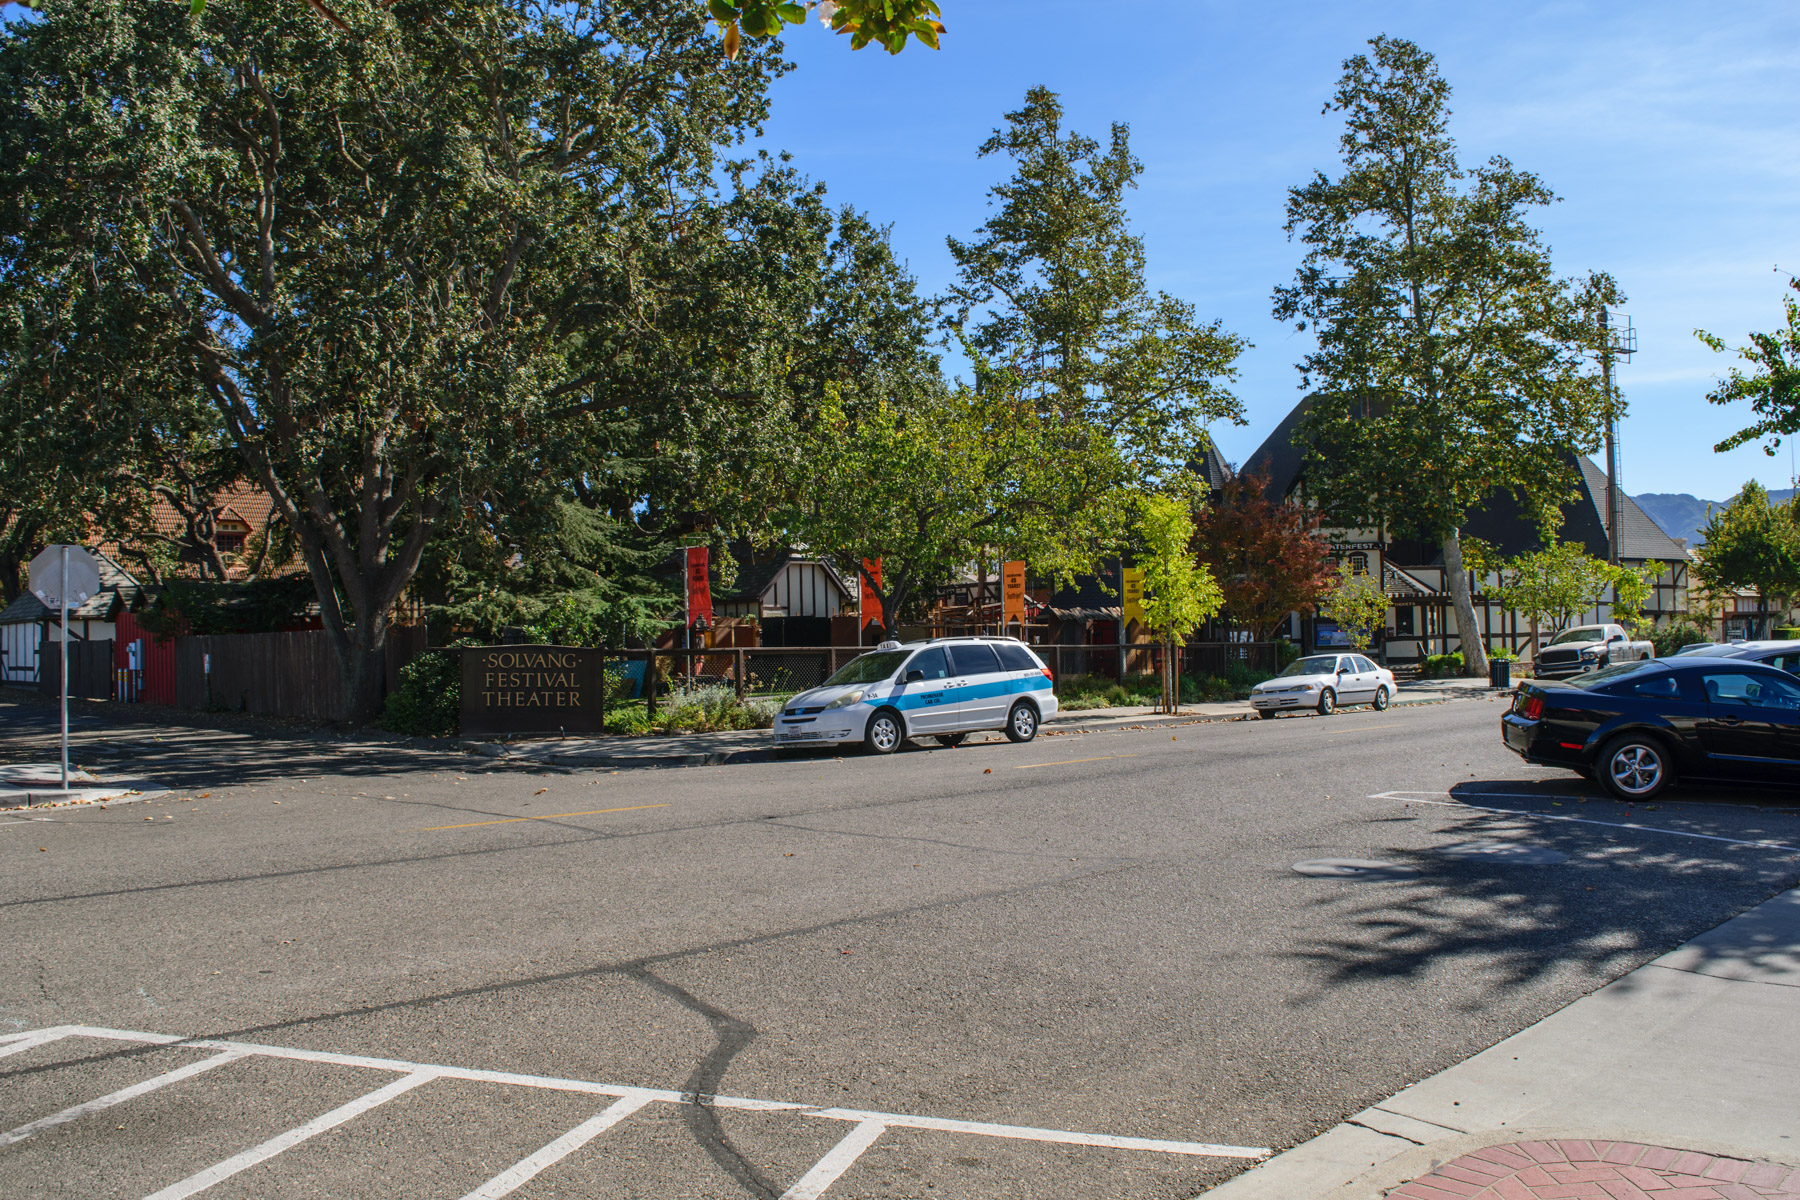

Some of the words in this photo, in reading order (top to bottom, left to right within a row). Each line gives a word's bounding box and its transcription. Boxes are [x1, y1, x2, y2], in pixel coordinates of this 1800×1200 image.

[487, 653, 577, 668] SOLVANG
[485, 672, 580, 688] FESTIVAL
[482, 691, 580, 706] THEATER
[920, 692, 944, 700] PROMENADE
